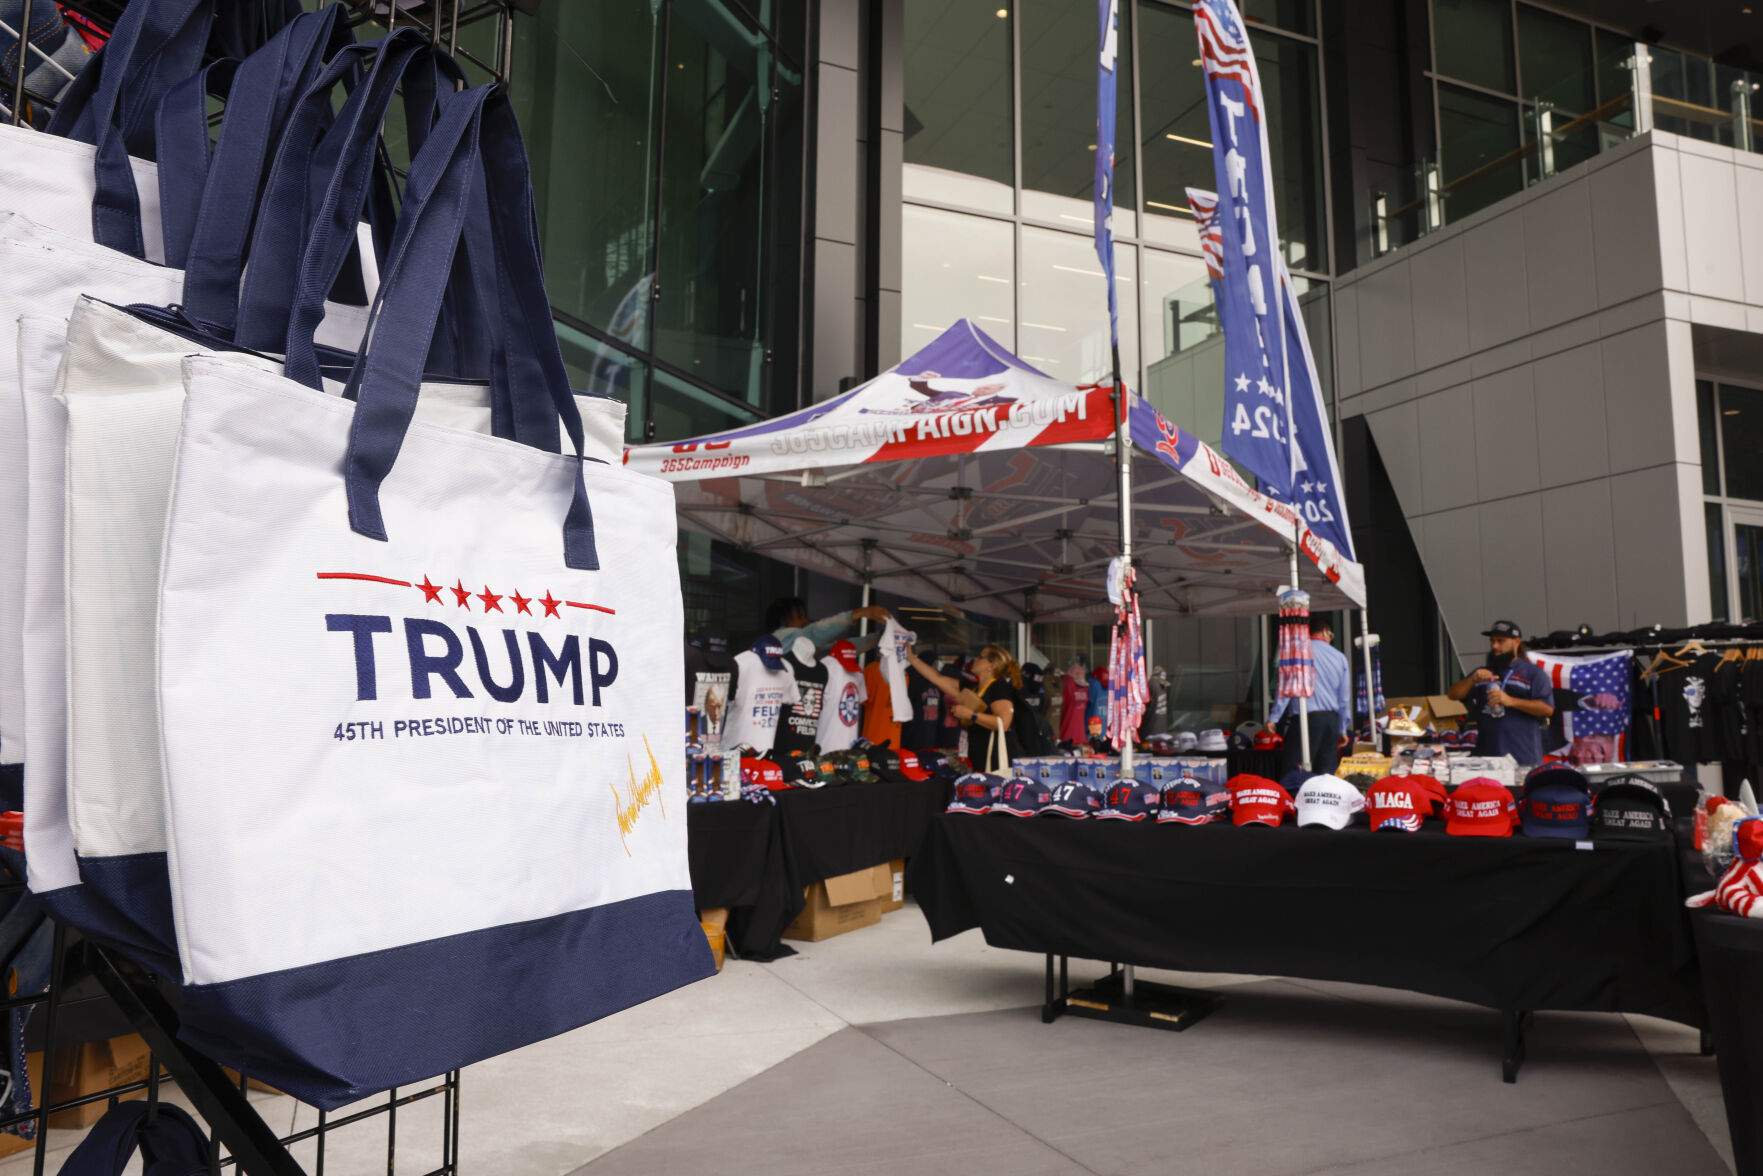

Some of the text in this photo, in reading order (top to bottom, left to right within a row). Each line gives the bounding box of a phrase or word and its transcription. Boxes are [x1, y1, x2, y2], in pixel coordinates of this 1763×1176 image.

[660, 453, 750, 473] 365Campaign
[325, 612, 619, 708] TRUMP
[333, 716, 625, 741] 45TH PRESIDENT OF THE UNITED STATES
[1003, 783, 1025, 800] 47
[1052, 784, 1075, 802] 47
[1109, 787, 1132, 805] 47
[1317, 791, 1342, 800] AMERICA
[1374, 792, 1414, 809] MAGA
[1471, 800, 1501, 811] AMERICA
[1477, 808, 1499, 818] AGAIN
[1622, 811, 1654, 820] AMERICA
[1629, 820, 1652, 828] AGAIN
